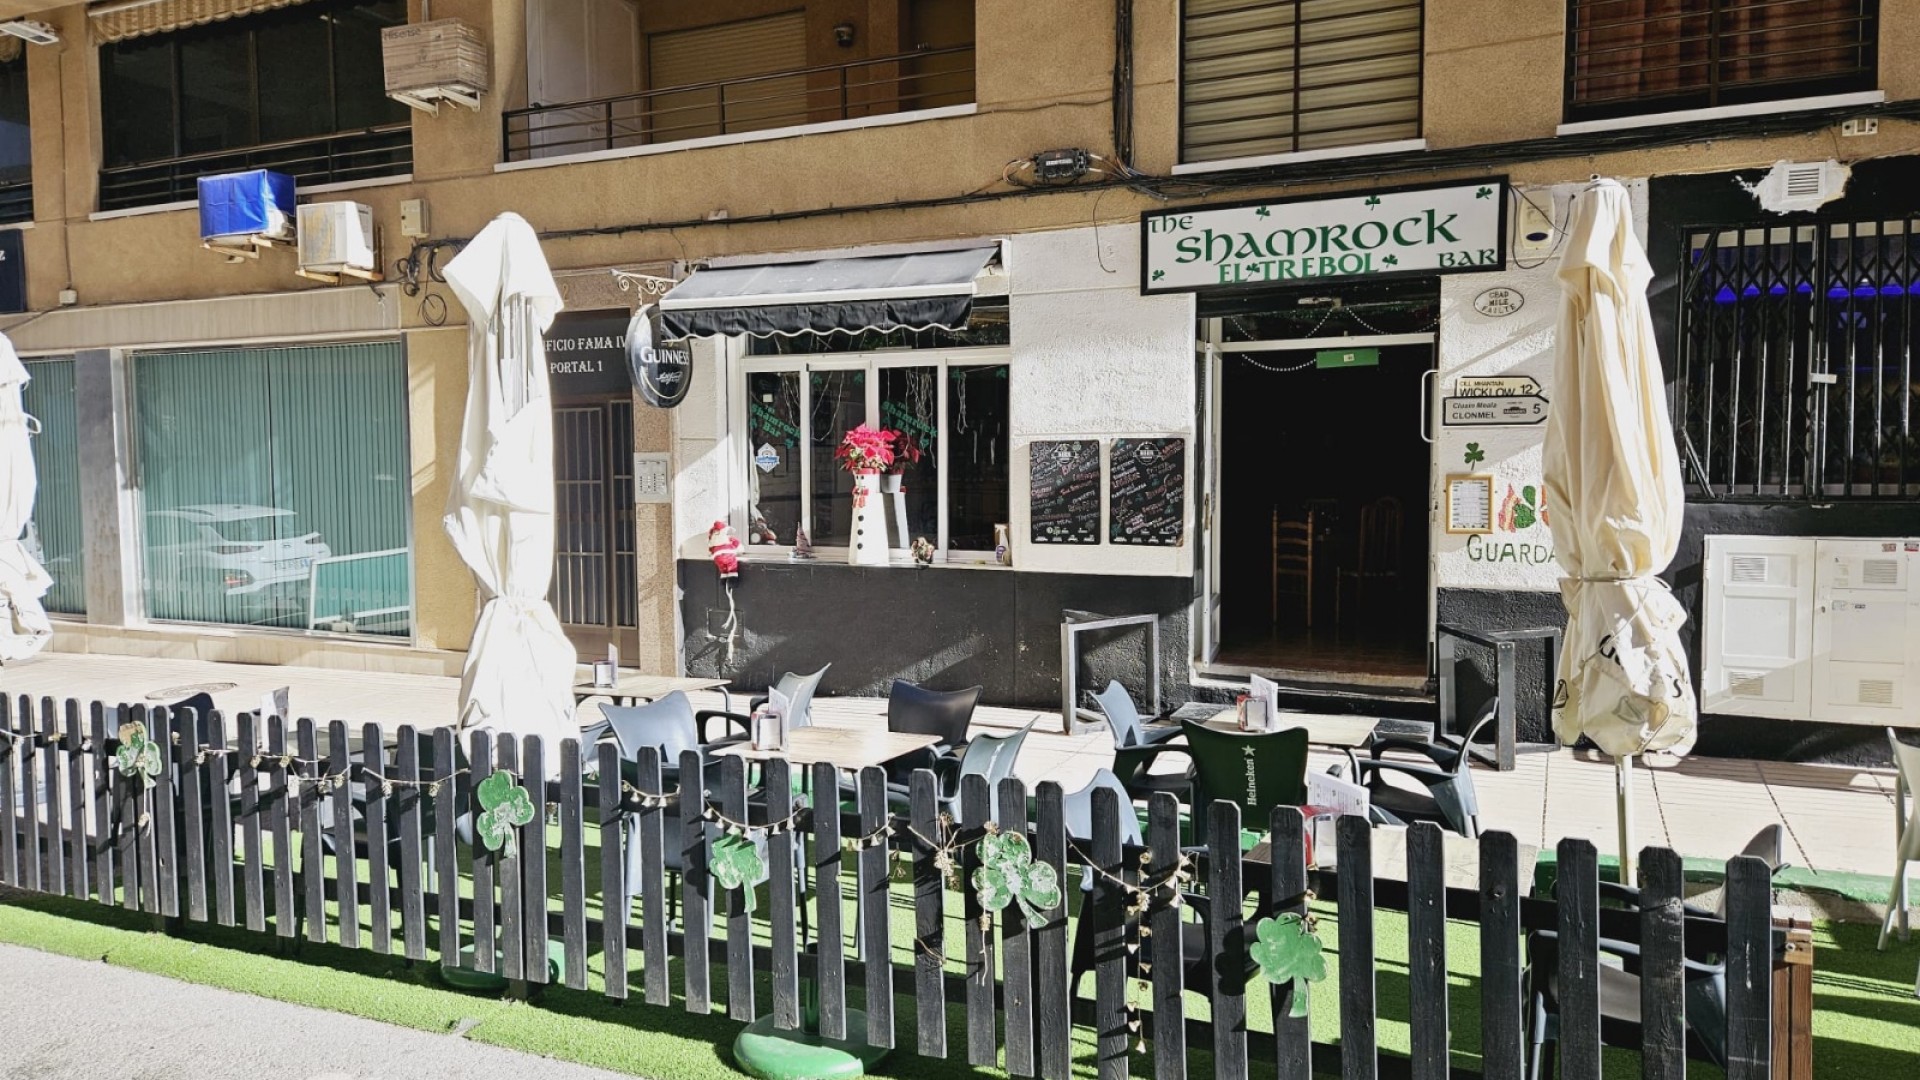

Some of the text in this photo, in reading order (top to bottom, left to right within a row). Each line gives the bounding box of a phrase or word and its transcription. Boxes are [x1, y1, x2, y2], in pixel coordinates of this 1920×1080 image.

[1437, 247, 1498, 270] BAR
[1217, 251, 1380, 285] EL TREBOL
[1488, 298, 1509, 306] MILE
[544, 338, 576, 352] FICIO
[577, 336, 613, 350] FAMA
[640, 346, 690, 365] GUINNESS
[550, 360, 603, 374] PORTAL 1
[1459, 384, 1533, 397] WICKLOW 12
[1452, 411, 1496, 419] CLONMEL
[1532, 403, 1541, 414] 5
[762, 422, 781, 438] Bar
[1245, 757, 1257, 806] Heineken
